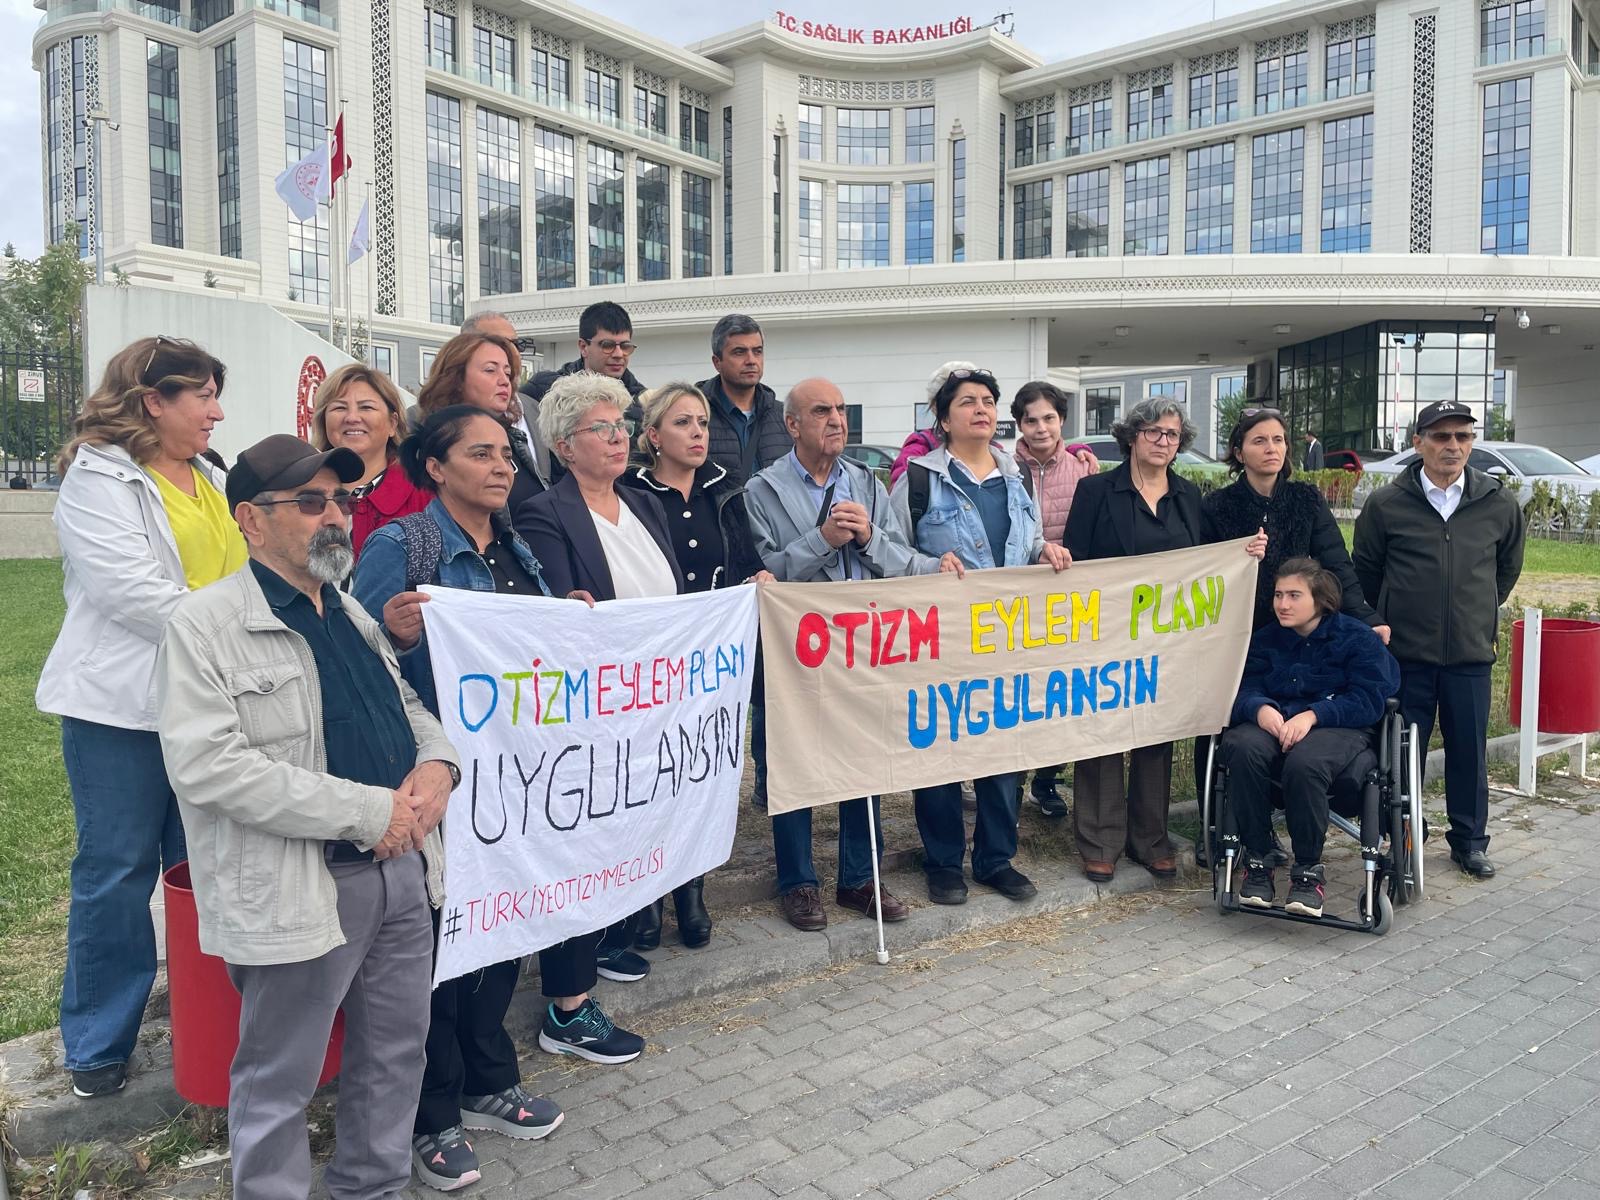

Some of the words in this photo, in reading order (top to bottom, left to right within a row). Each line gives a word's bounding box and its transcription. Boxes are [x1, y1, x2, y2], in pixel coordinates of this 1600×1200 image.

[803, 21, 864, 44] SAĞLIK
[873, 16, 972, 44] BAKANLIĞI
[796, 602, 940, 669] OTİZM
[970, 589, 1100, 654] EYLEM
[1130, 576, 1225, 640] PLANI
[459, 658, 589, 732] OTİZM
[597, 656, 685, 716] EYLEM
[907, 655, 1158, 749] UYGULANSIN
[471, 702, 741, 845] UYGULANSIN
